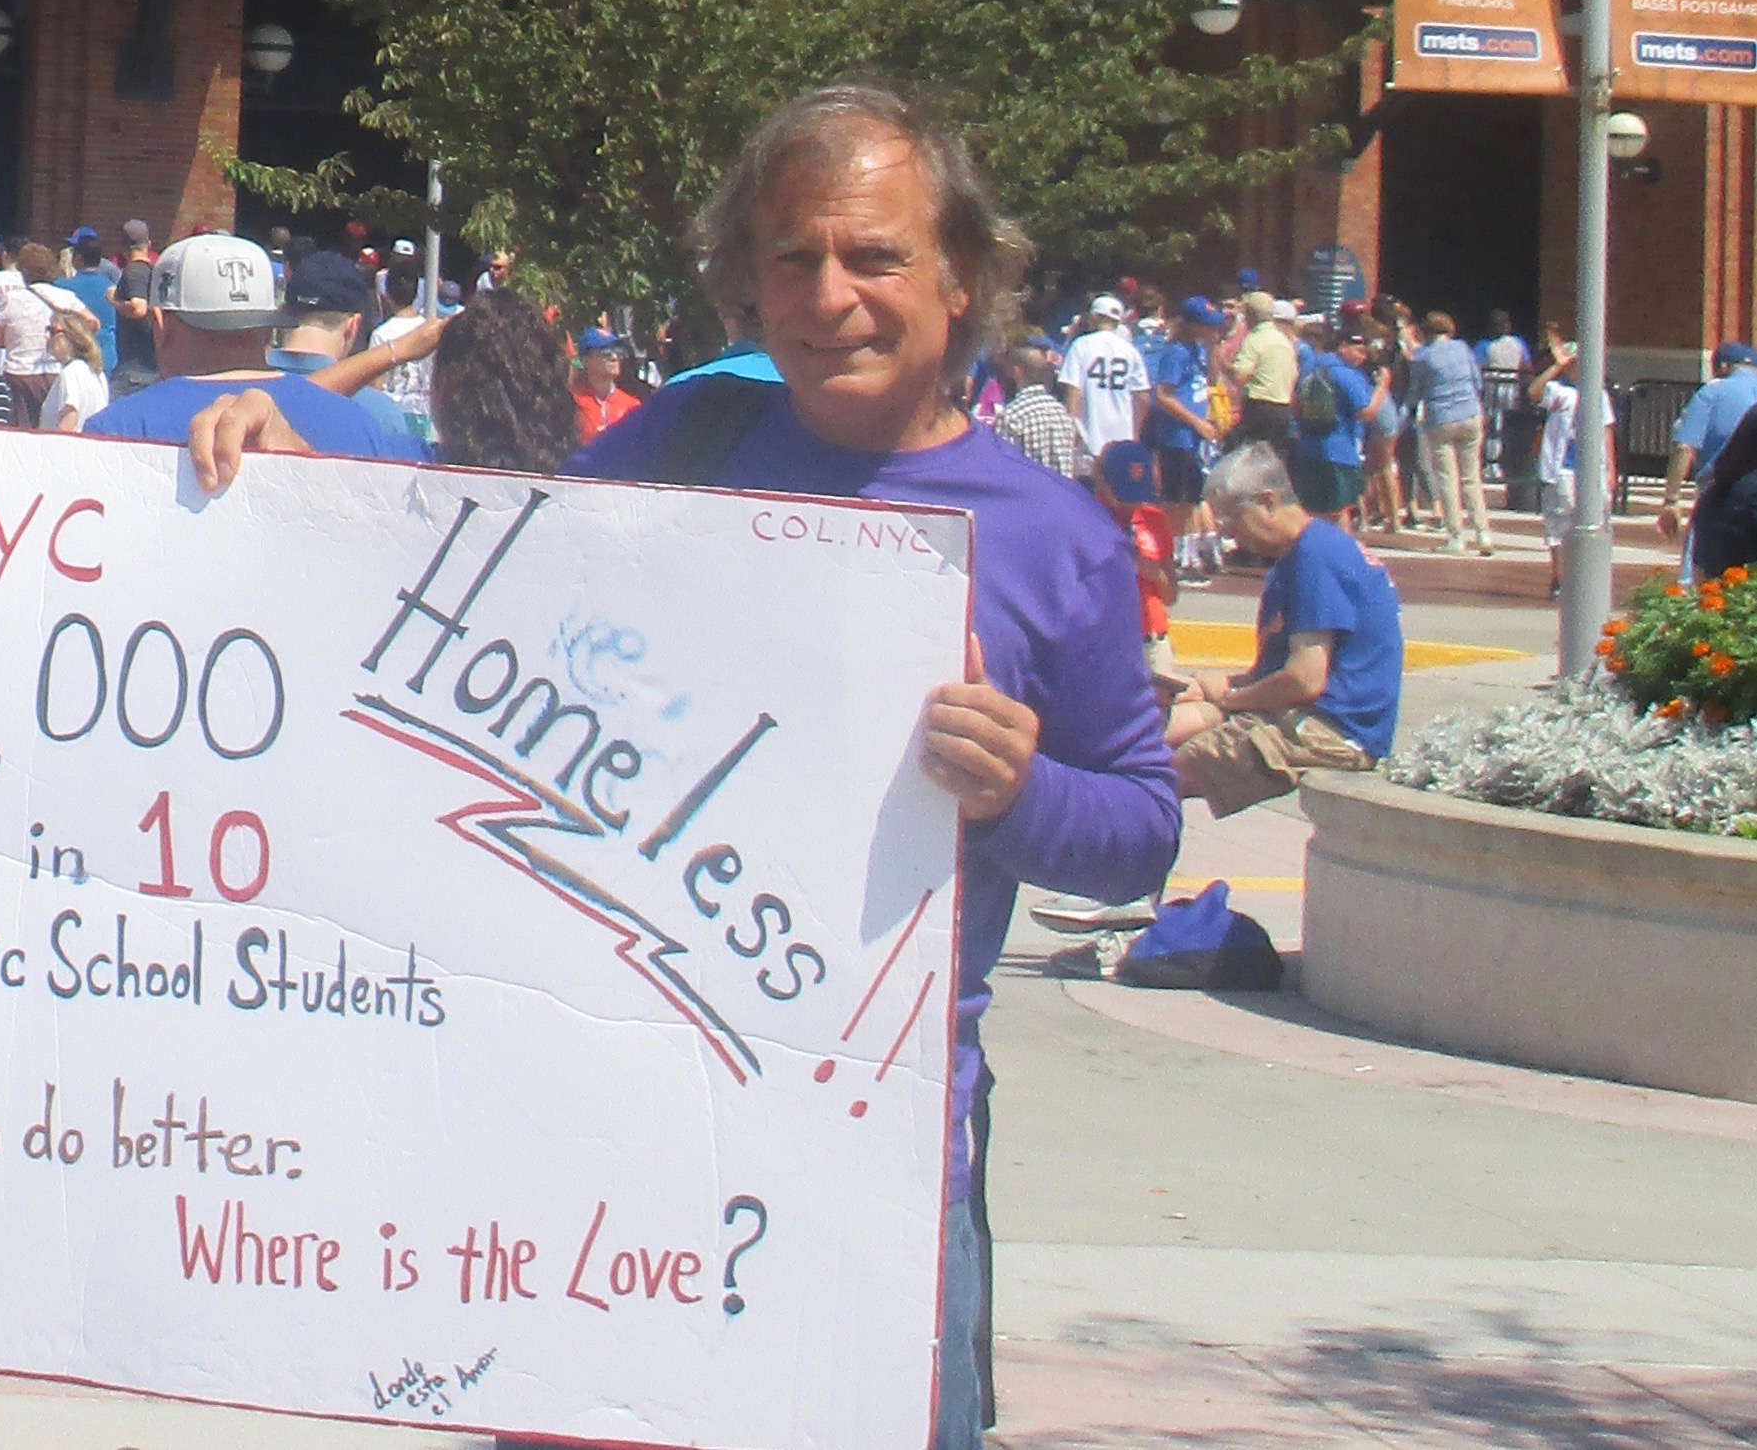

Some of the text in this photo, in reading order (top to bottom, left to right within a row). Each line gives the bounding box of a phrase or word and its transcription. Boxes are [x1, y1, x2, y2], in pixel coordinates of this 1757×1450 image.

[1680, 1, 1757, 17] POSTGAME
[1423, 33, 1535, 54] mets.com
[1640, 43, 1754, 66] mets.com
[217, 257, 254, 302] T
[1087, 356, 1129, 390] 42
[28, 821, 91, 886] in
[138, 790, 270, 902] 10
[47, 909, 203, 1005] School
[227, 927, 446, 1028] Students
[22, 1081, 85, 1165] do
[113, 1077, 304, 1180] better.
[175, 1194, 769, 1315] Where is the Love?
